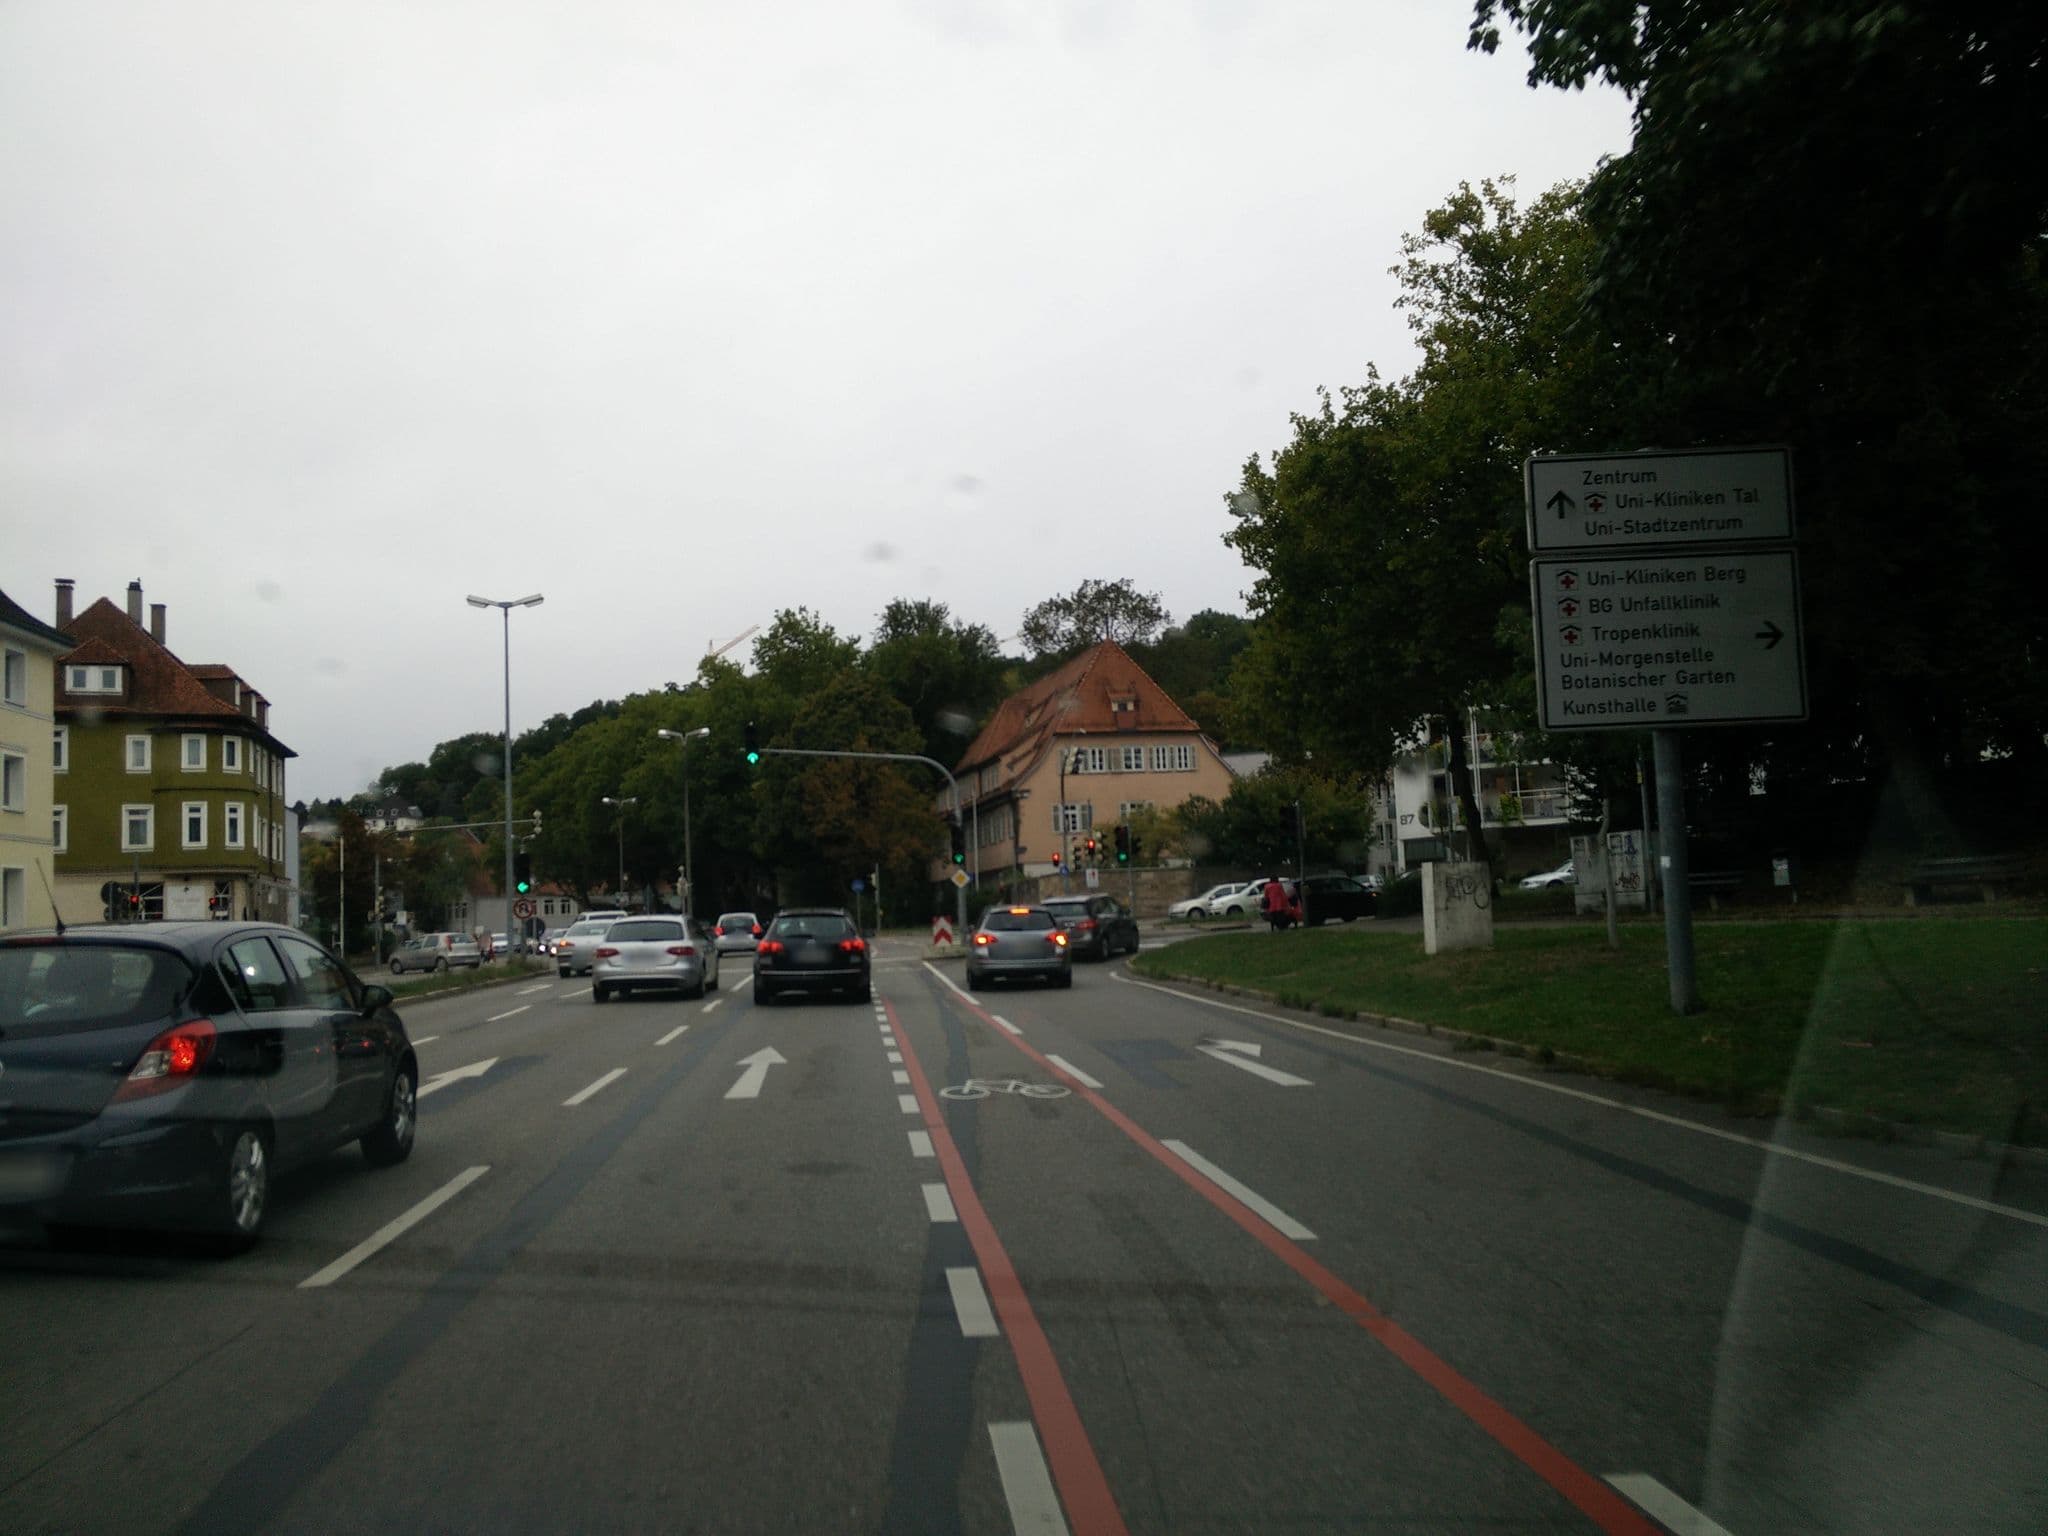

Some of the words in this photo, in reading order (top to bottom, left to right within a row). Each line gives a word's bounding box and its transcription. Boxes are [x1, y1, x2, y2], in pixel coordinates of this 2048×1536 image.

[1583, 470, 1657, 486] Zentrum
[1616, 489, 1725, 509] Uni-Kliniken
[1732, 488, 1760, 504] Tal
[1585, 517, 1743, 536] Uni-Stadtzentrum
[1587, 568, 1696, 586] Uni-Kliniken
[1704, 566, 1746, 583] Berg
[1589, 598, 1613, 614] BG
[1620, 594, 1720, 612] Unfallklinik
[1592, 623, 1701, 643] Tropenklinik
[1560, 648, 1714, 669] Uni-Morgenstelle
[1561, 673, 1666, 690] Botanischer
[1675, 670, 1736, 685] Garten
[1563, 698, 1657, 716] Kunsthalle
[1400, 813, 1414, 825] 87
